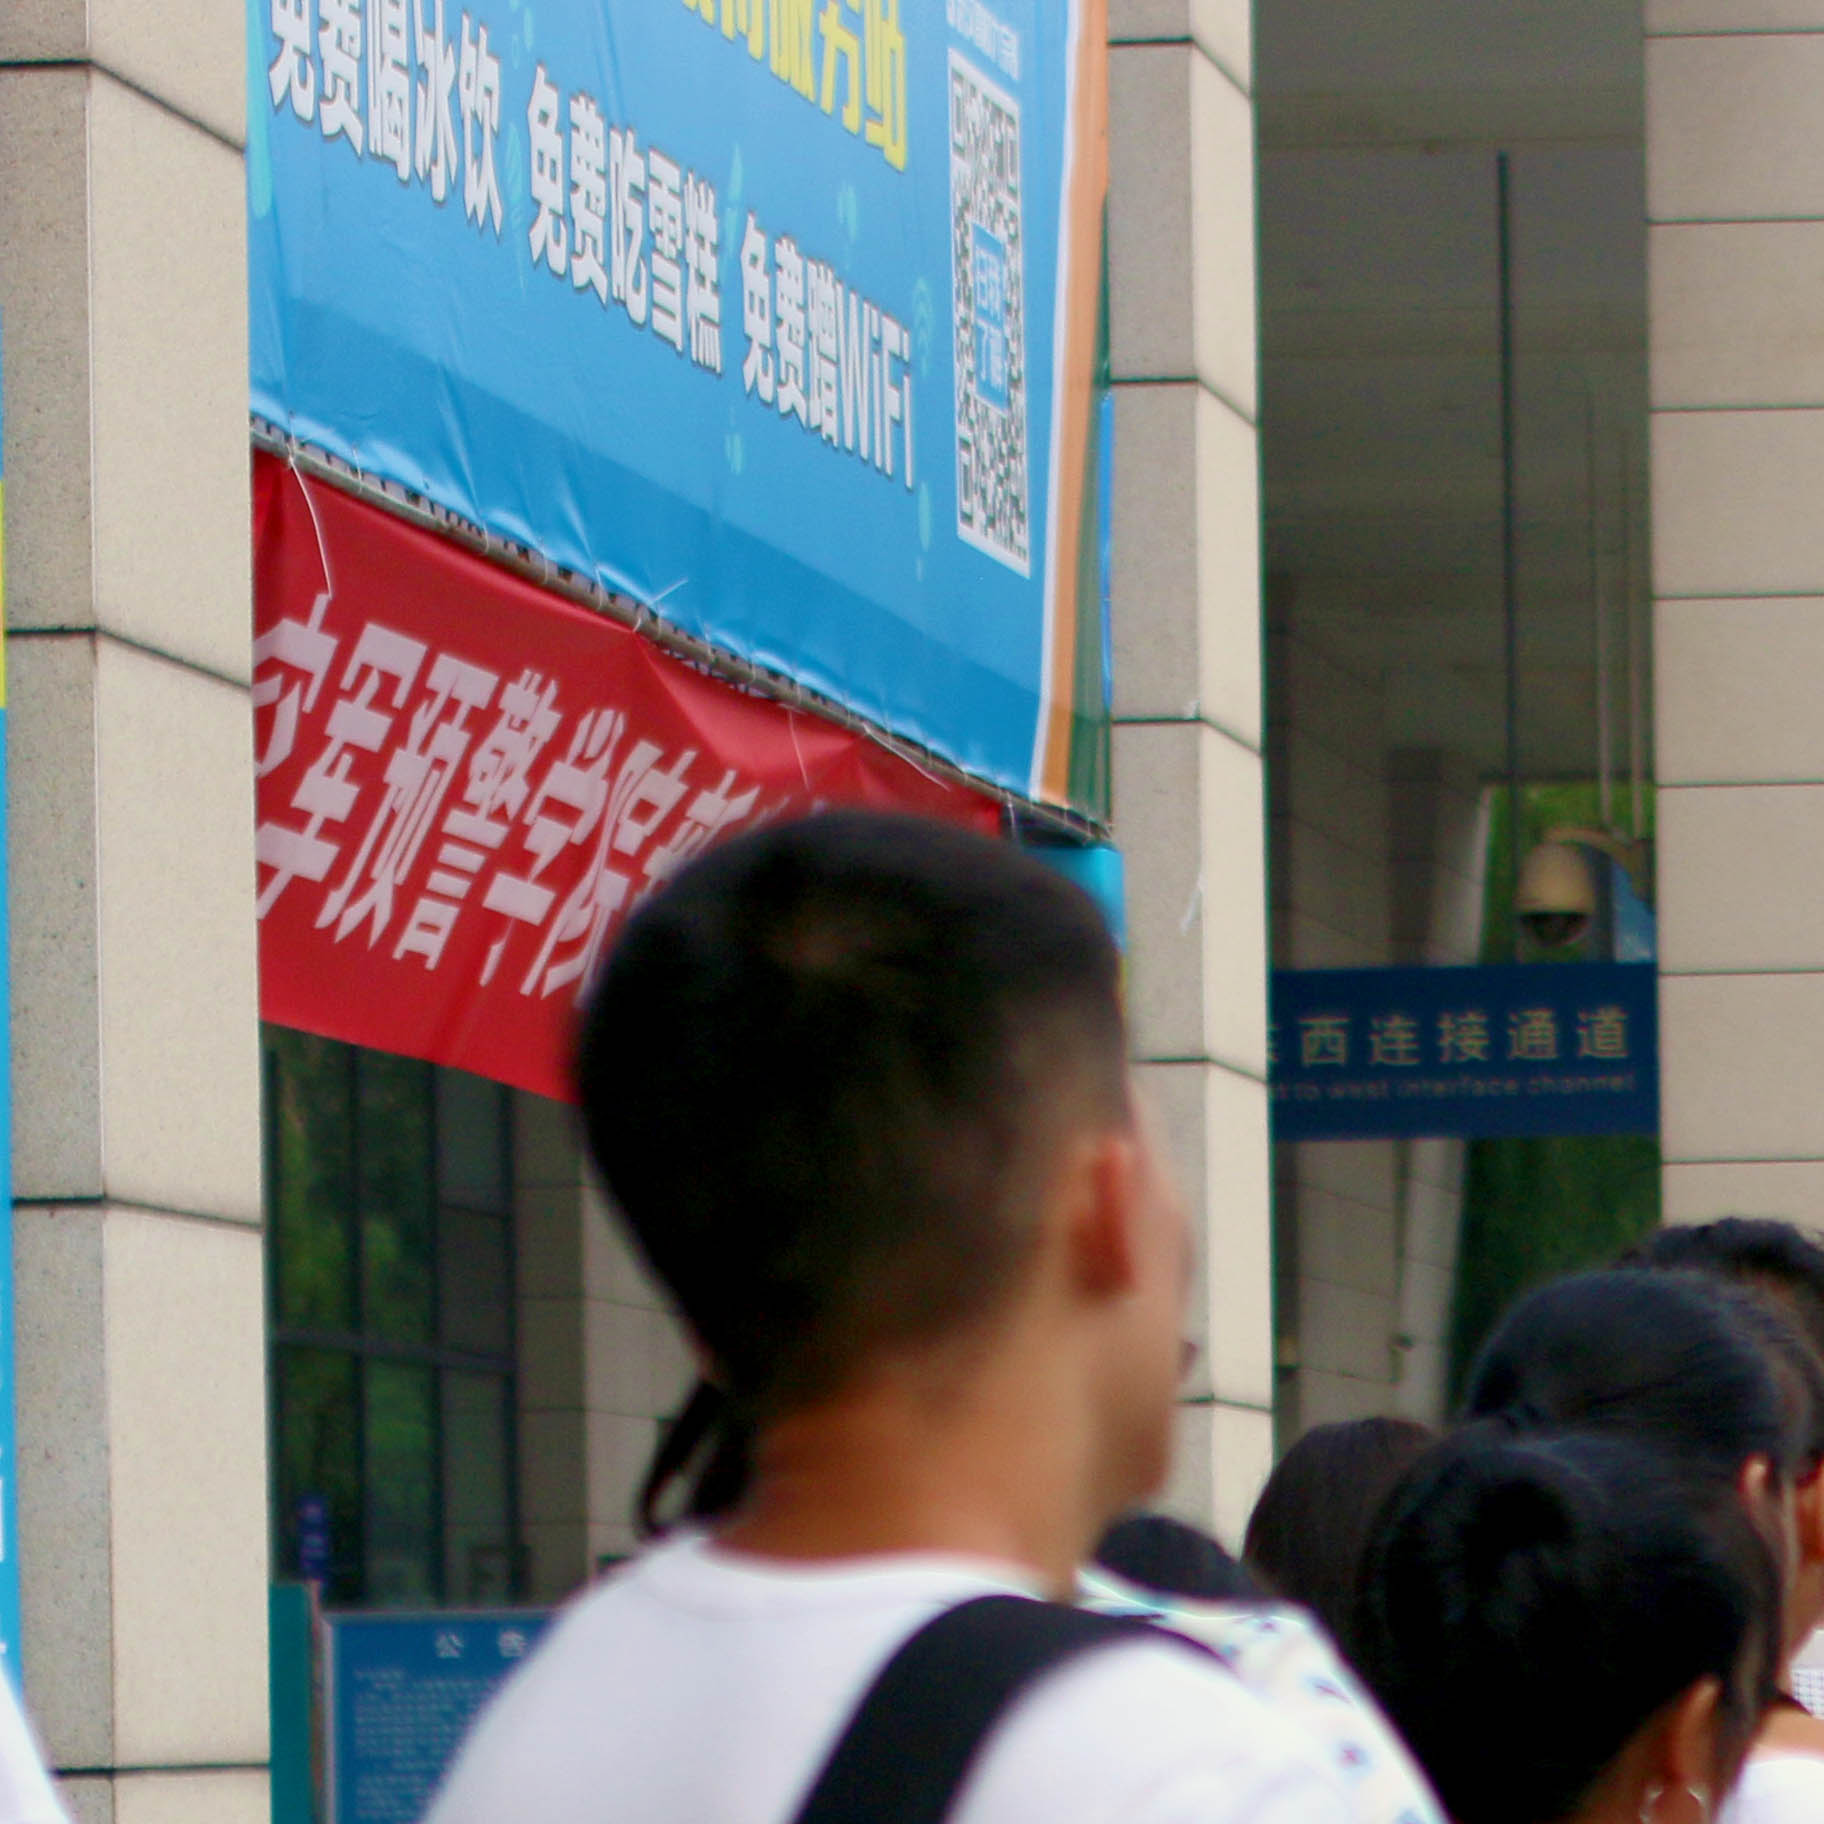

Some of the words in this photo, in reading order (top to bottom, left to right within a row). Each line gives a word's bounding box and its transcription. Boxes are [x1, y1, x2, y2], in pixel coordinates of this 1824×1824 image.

[528, 66, 722, 376] 免费吃雪糕
[1328, 1080, 1390, 1101] west
[1399, 1075, 1520, 1098] interface
[1526, 1072, 1634, 1095] channel
